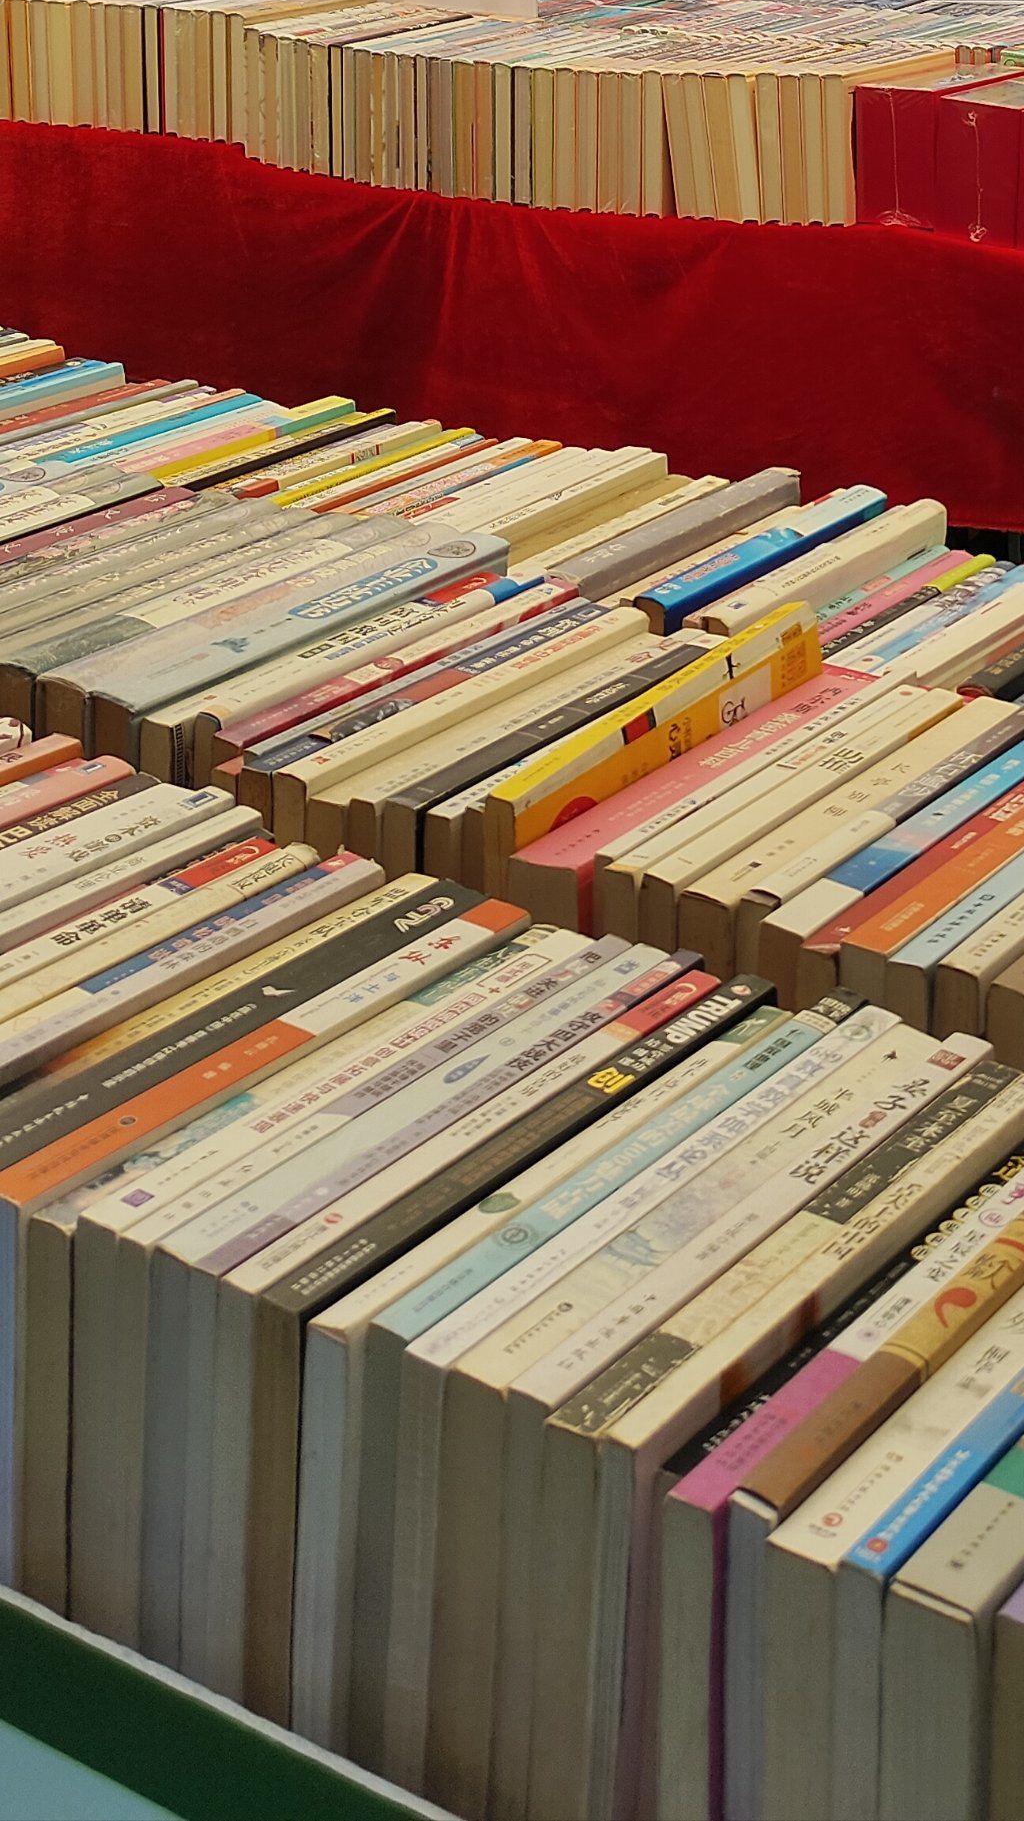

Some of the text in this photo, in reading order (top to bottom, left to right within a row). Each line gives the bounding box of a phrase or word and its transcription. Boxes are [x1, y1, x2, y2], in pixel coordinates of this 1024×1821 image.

[326, 605, 423, 646] 富可敌国
[785, 683, 847, 716] 西尔斯
[812, 746, 871, 776] 助推
[24, 786, 126, 831] 全面解读
[45, 896, 155, 948] 清单革命
[385, 894, 461, 933] CCTV
[502, 1009, 606, 1071] 攻守四大战技
[653, 992, 746, 1044] TRUMP
[577, 1064, 638, 1096] 创
[894, 1093, 981, 1154] 夏至未至
[780, 1123, 875, 1187] 这样说
